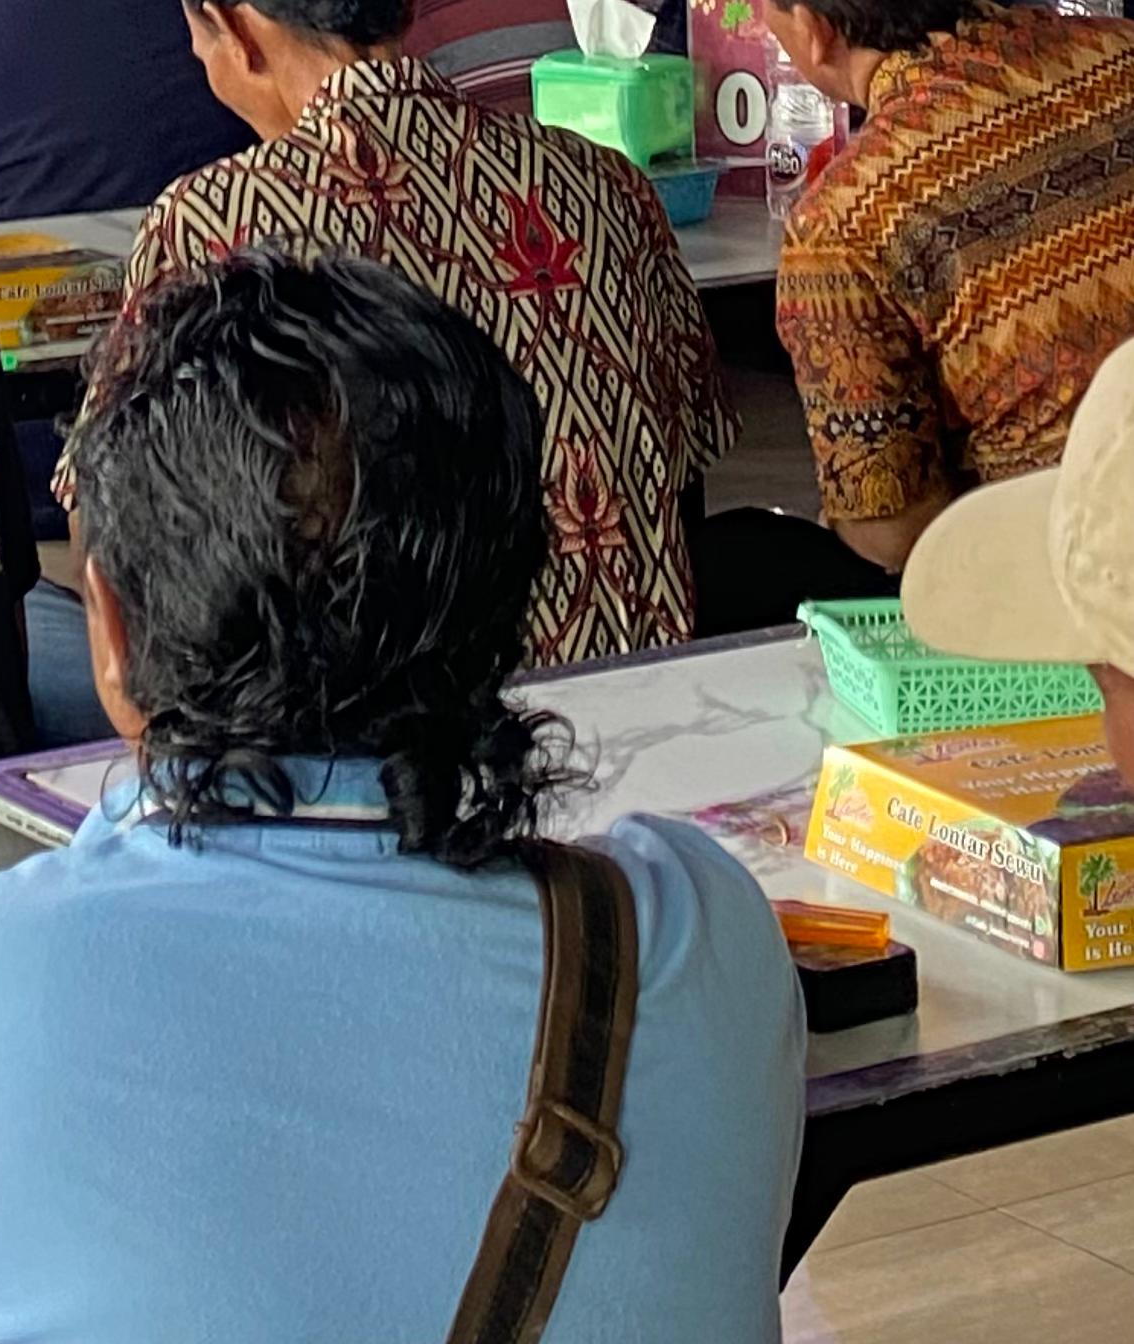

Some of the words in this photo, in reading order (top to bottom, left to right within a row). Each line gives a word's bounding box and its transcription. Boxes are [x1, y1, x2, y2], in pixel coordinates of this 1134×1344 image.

[888, 796, 923, 831] Cafe
[929, 814, 988, 859] Lontar
[989, 841, 1044, 883] Sewu
[1085, 922, 1126, 939] Your
[1085, 946, 1102, 961] is
